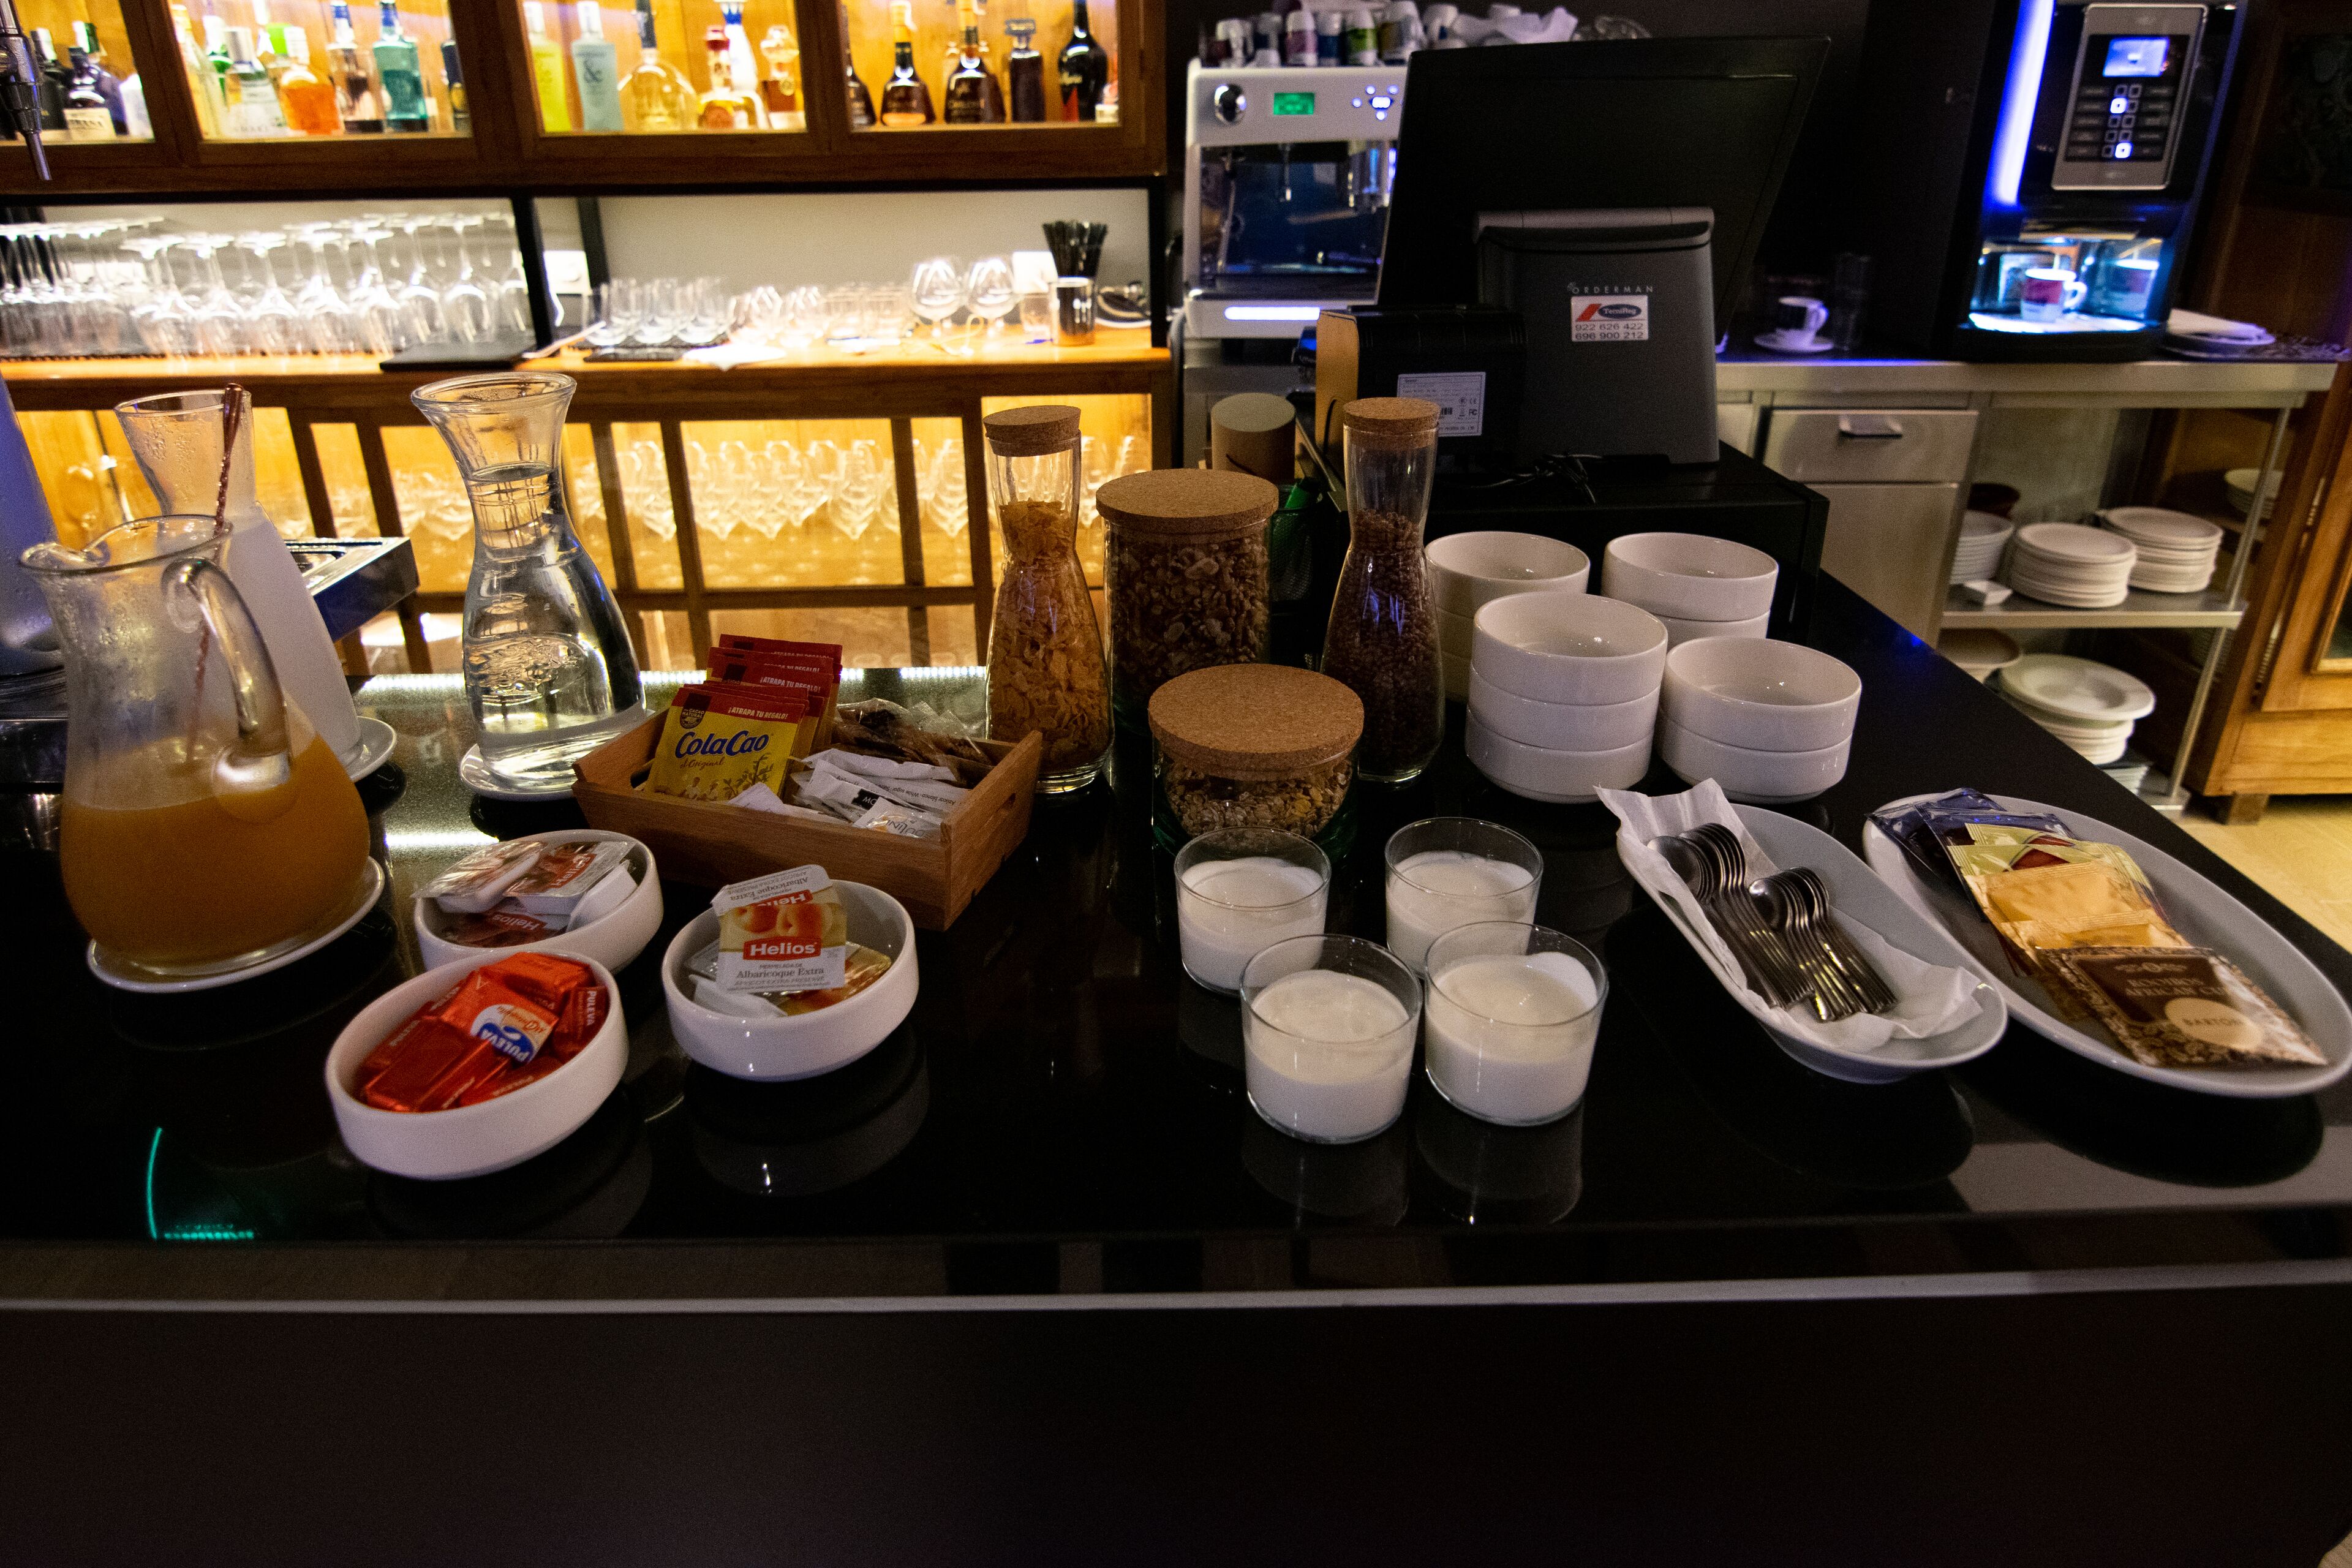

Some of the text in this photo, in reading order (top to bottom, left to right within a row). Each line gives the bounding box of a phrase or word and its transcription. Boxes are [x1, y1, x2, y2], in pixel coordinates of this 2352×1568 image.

[1572, 285, 1653, 294] ORDERMAN
[760, 676, 785, 685] ¡ATRAPA
[728, 707, 755, 716] ¡ATRAPA
[675, 729, 770, 759] ColaCao
[492, 914, 541, 930] Helios
[750, 942, 815, 956] Helios
[737, 970, 795, 978] Albaricoque
[480, 1028, 530, 1063] PULEVA
